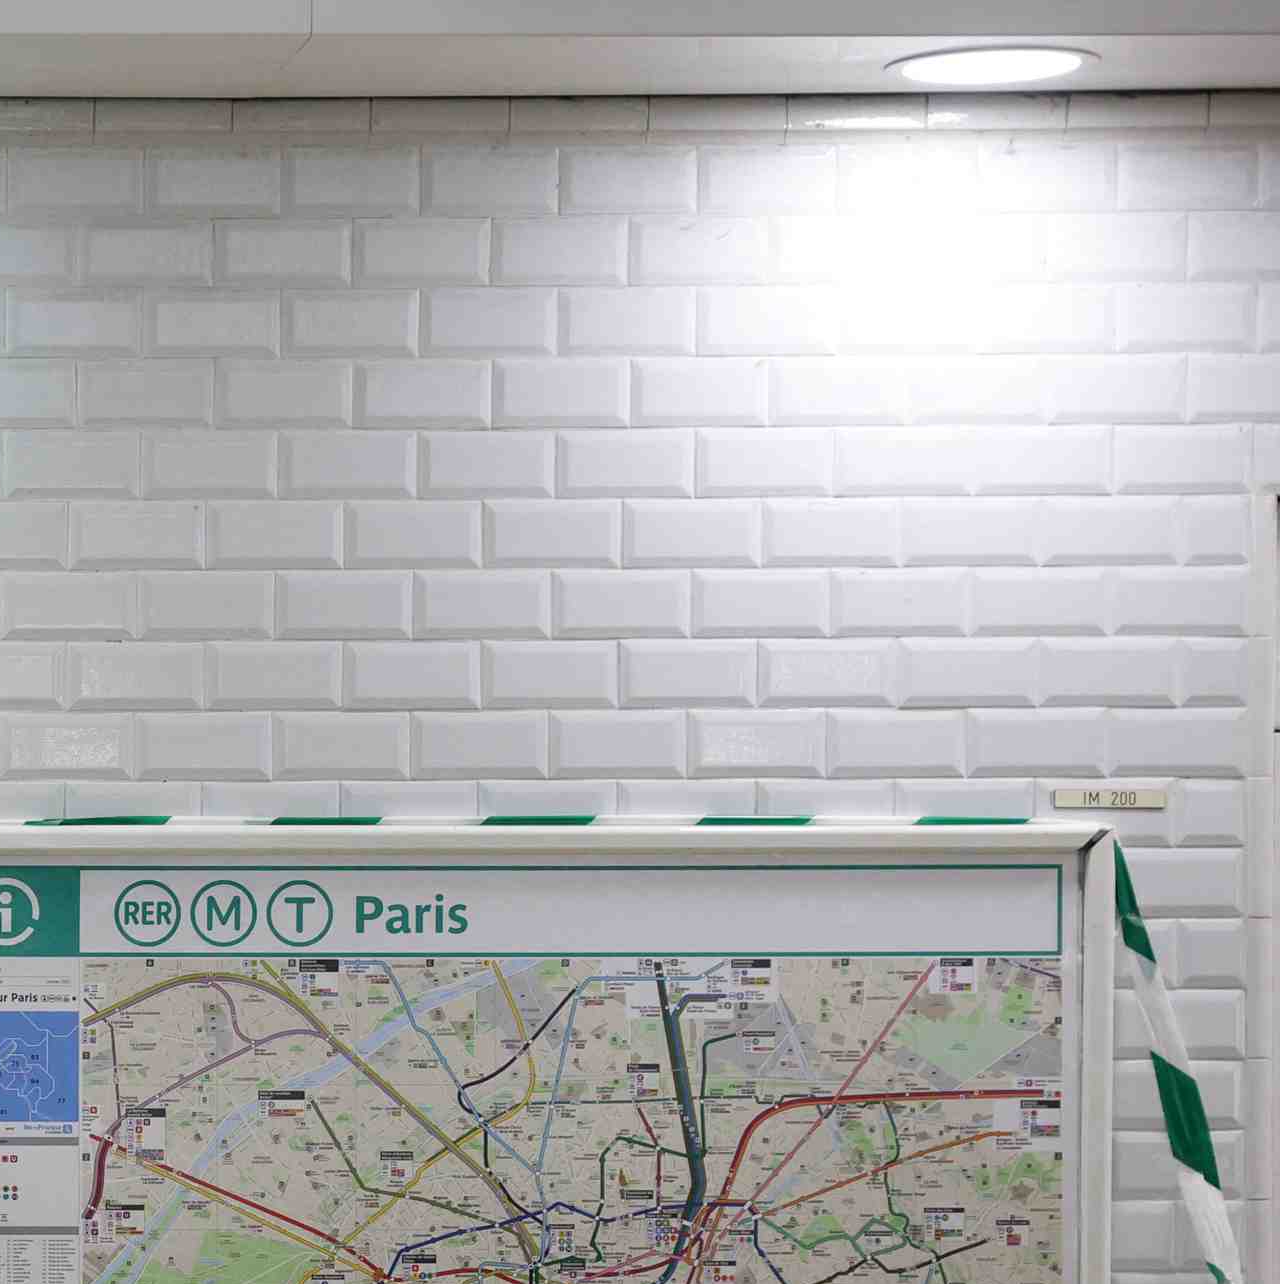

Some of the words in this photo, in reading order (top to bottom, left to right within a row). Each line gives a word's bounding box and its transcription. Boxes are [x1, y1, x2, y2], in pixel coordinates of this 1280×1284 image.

[1083, 791, 1100, 806] IM
[1111, 791, 1137, 806] 200
[123, 900, 173, 926] RER
[206, 898, 241, 931] M
[284, 897, 316, 934] T
[355, 894, 469, 935] Paris
[11, 992, 39, 1003] Paris
